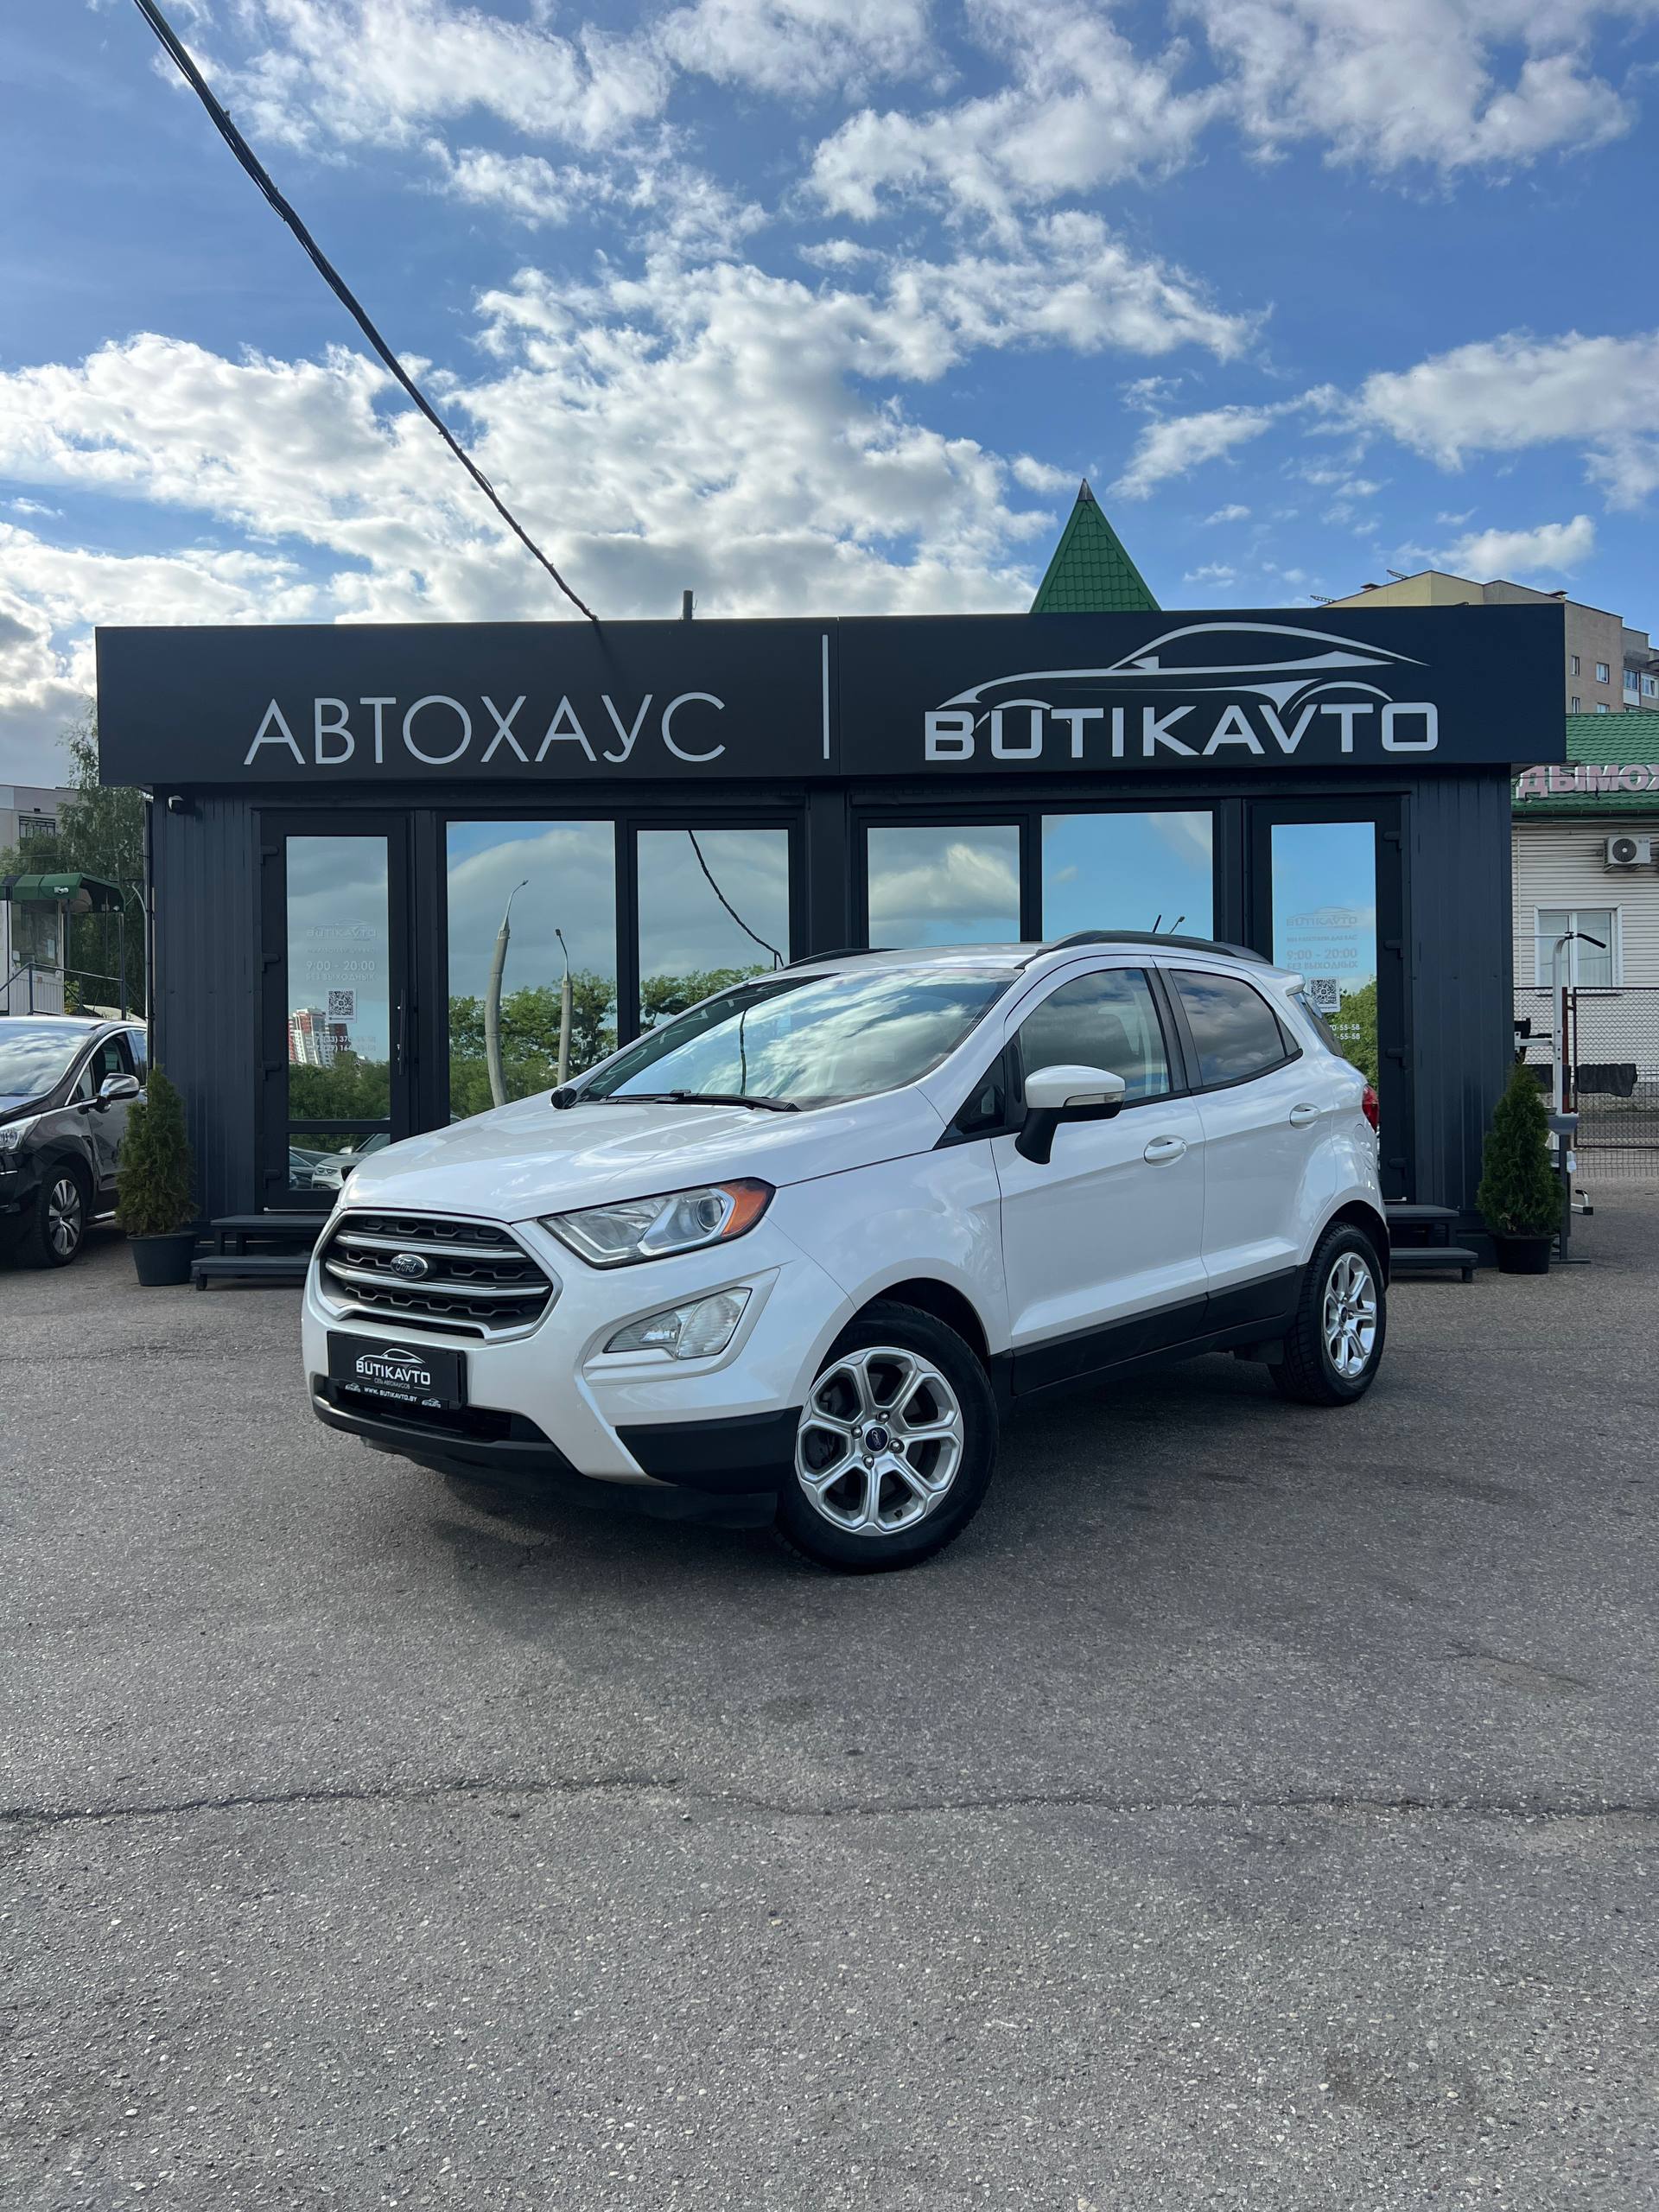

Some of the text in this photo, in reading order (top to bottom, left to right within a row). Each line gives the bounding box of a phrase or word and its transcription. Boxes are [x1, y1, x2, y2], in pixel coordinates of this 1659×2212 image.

[244, 692, 726, 766] АВТОХАУС
[925, 702, 1439, 761] BUTIKAVTO
[1287, 949, 1313, 960] 9:00
[1325, 948, 1357, 959] 20:00
[306, 960, 331, 971] 9:00
[343, 960, 375, 971] 20:00
[395, 1257, 417, 1273] Ford
[355, 1359, 432, 1386] BUTIKAVTO
